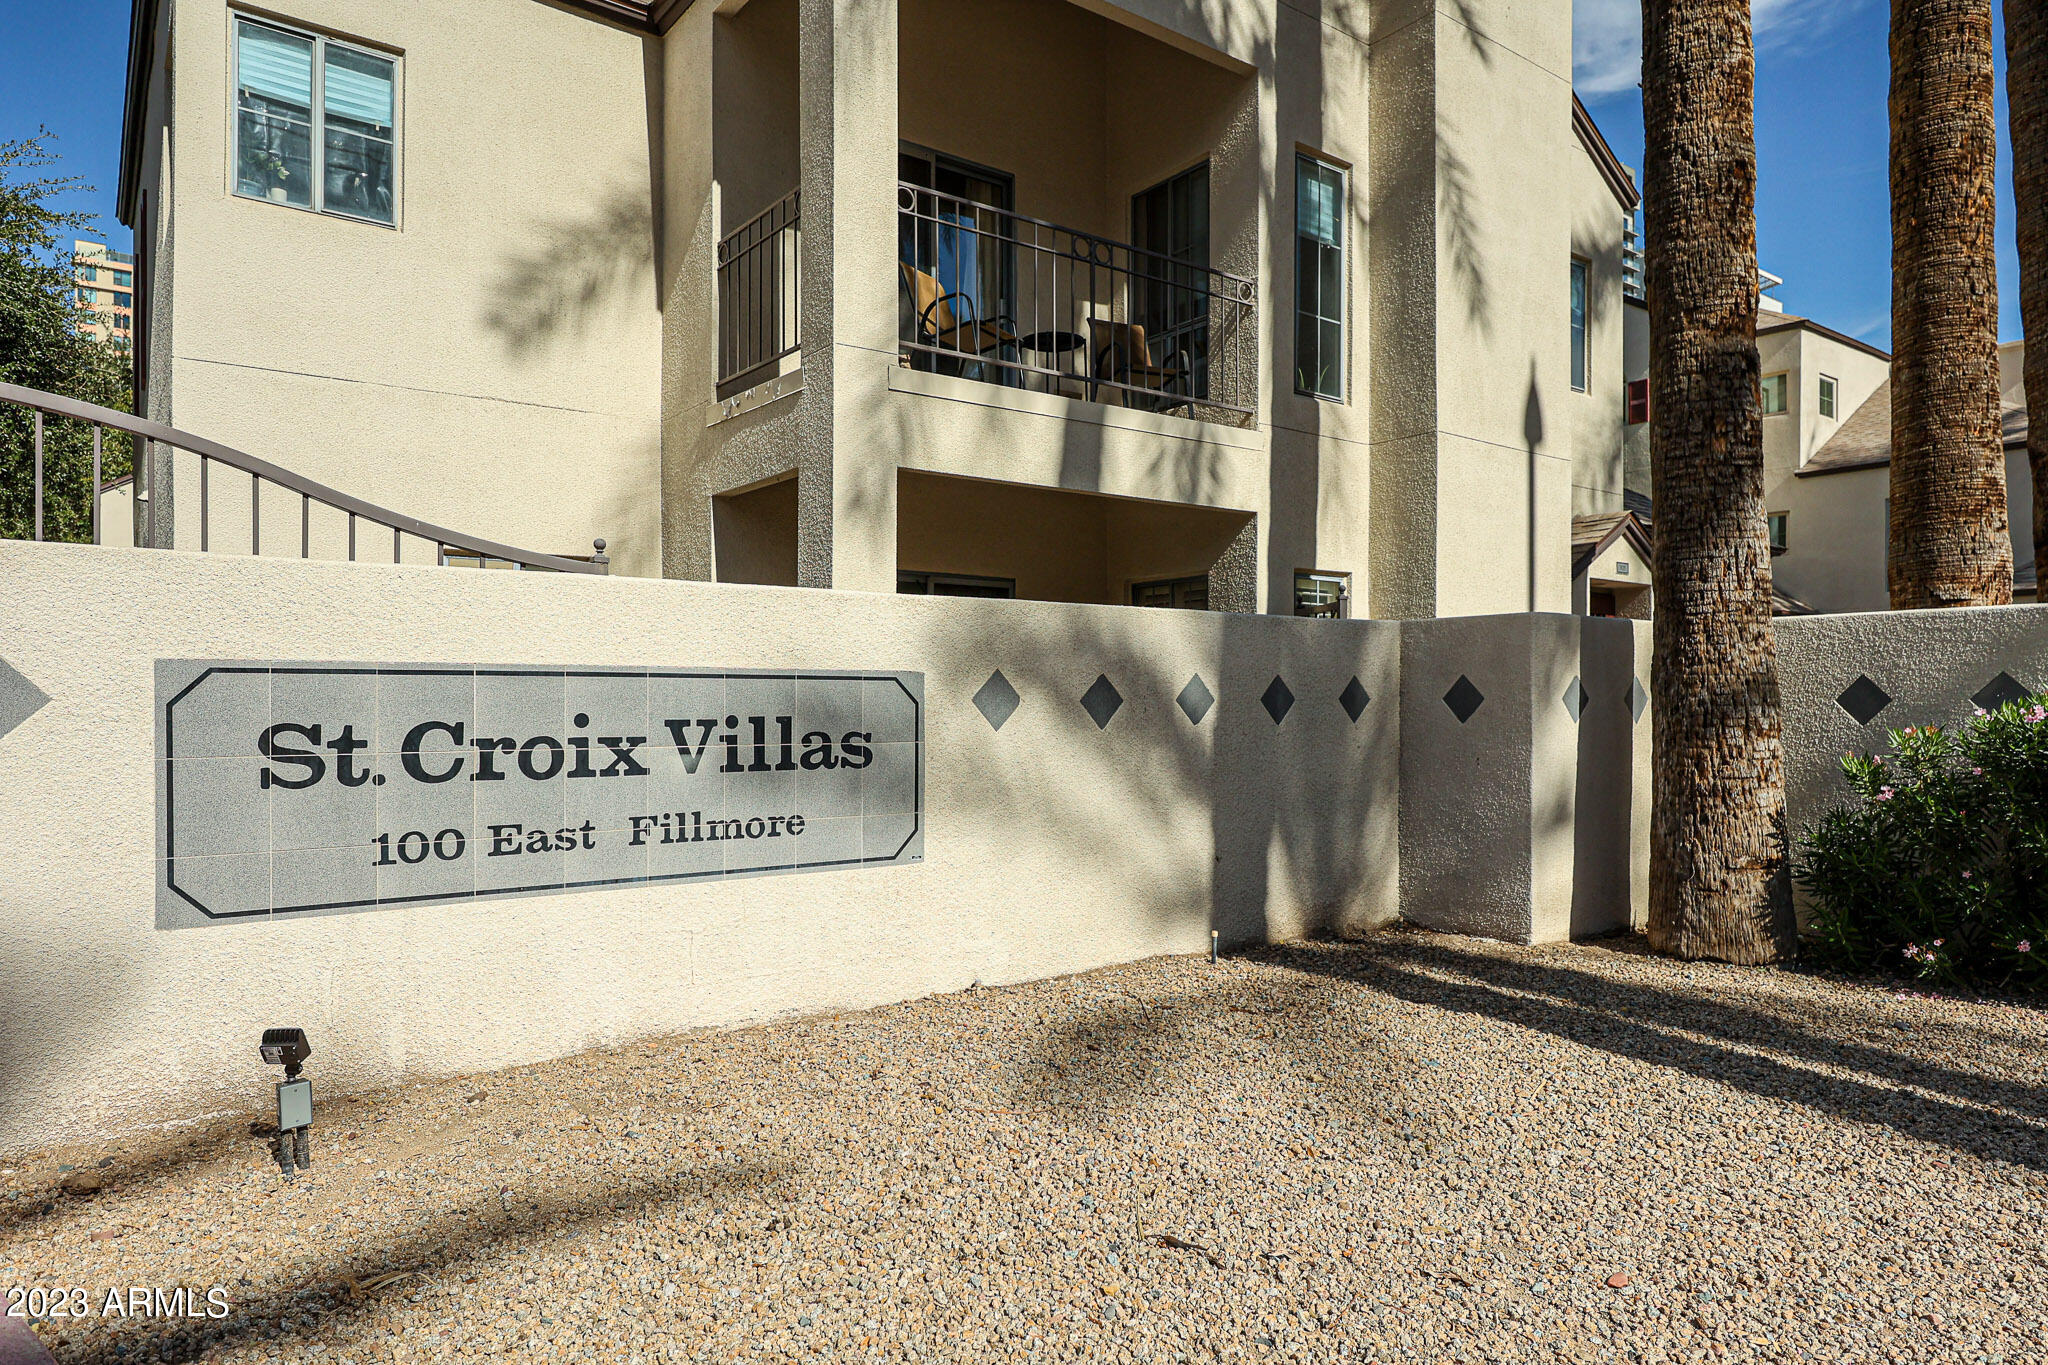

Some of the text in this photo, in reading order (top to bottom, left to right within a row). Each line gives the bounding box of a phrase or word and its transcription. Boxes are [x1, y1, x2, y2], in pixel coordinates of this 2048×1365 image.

[258, 712, 874, 790] St. Croix Villas
[373, 811, 806, 867] 100 East Fillmore
